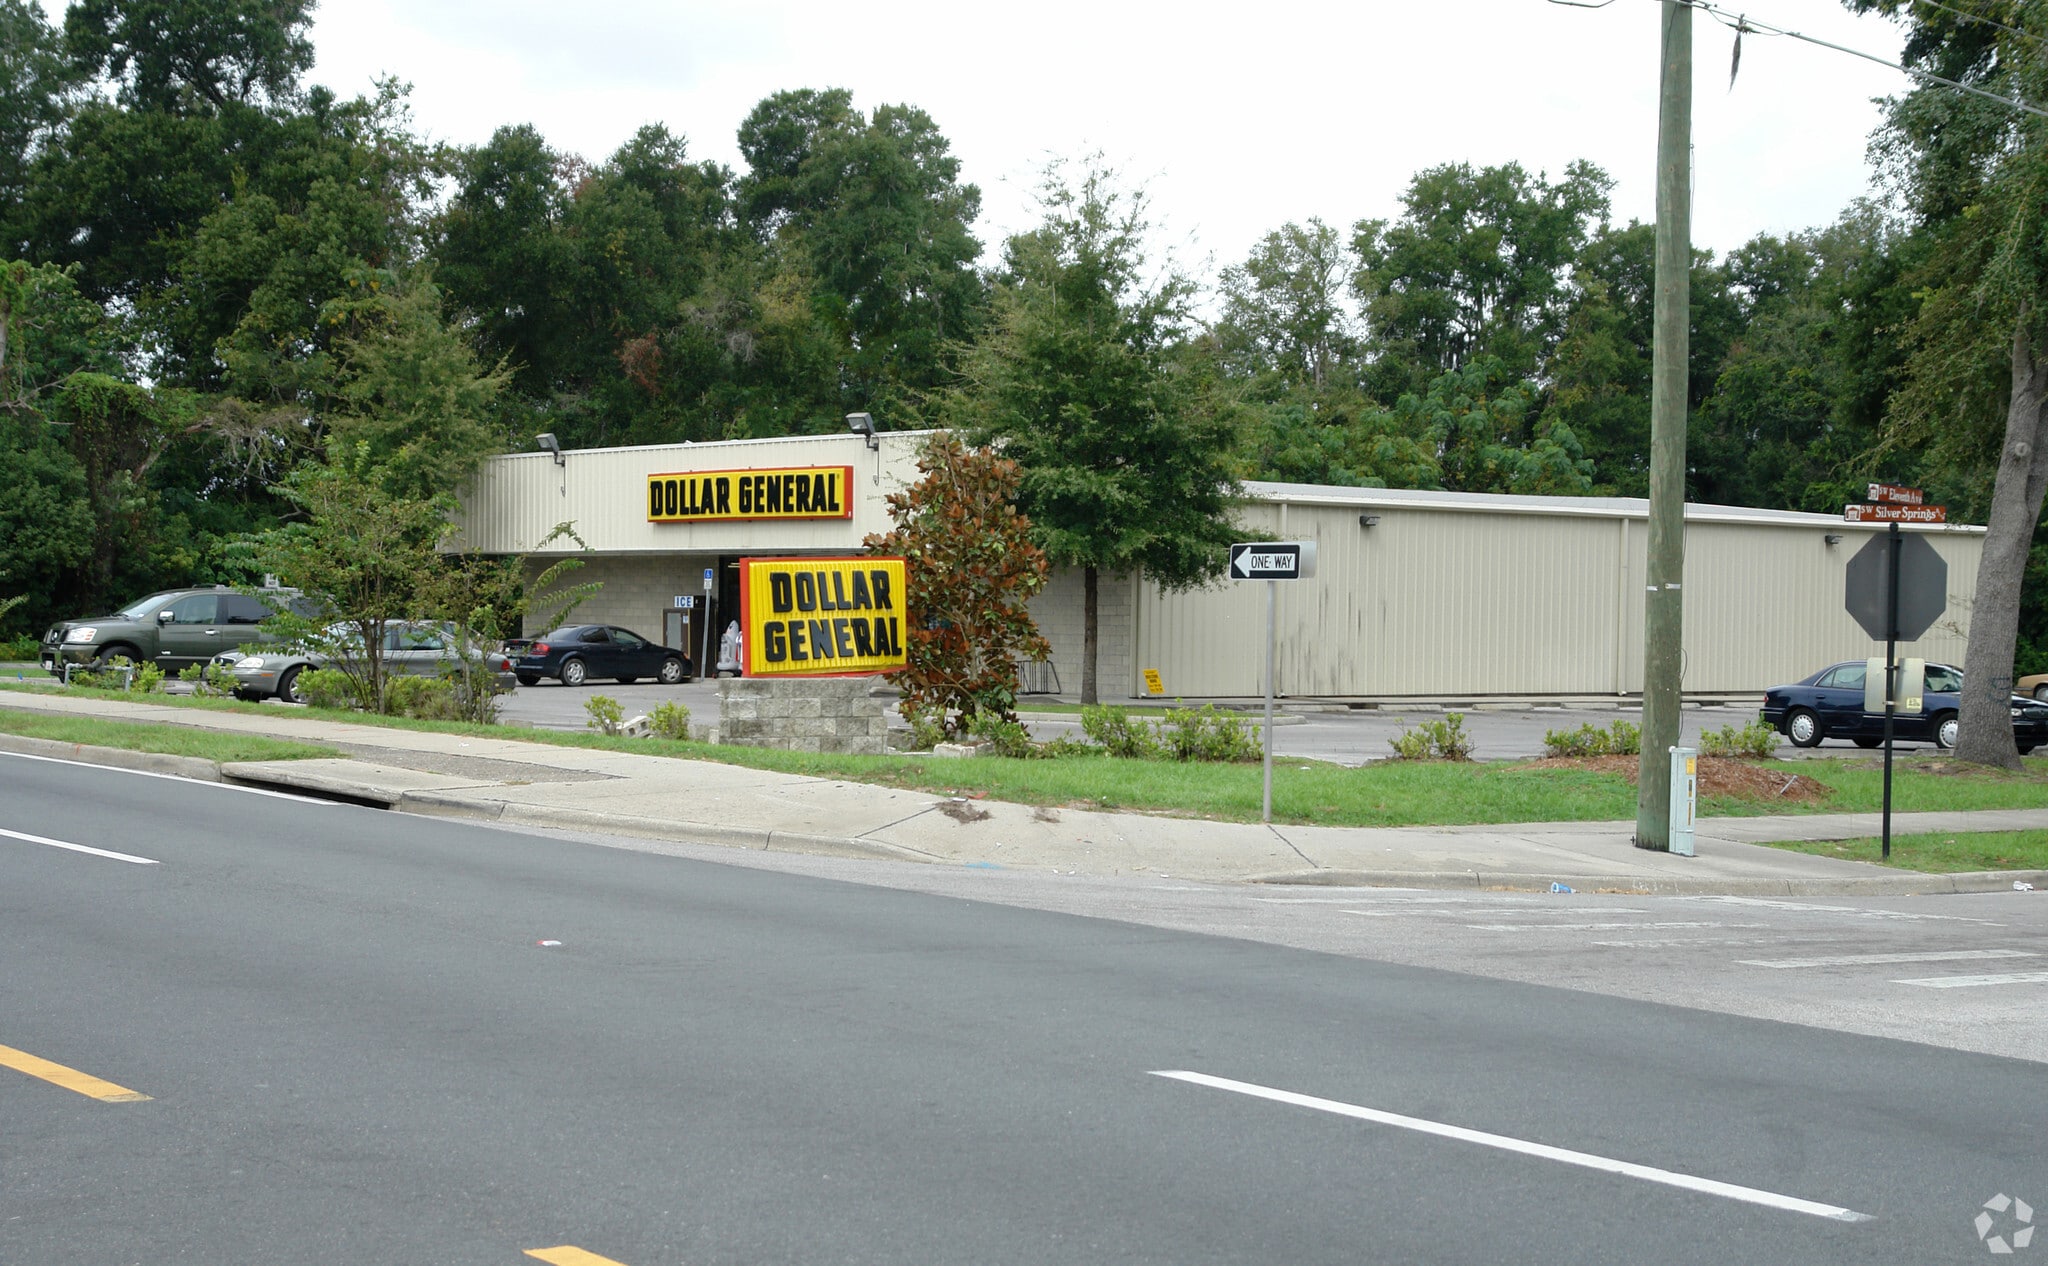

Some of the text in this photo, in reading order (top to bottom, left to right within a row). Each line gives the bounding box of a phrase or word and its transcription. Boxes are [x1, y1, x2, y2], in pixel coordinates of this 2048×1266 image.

[650, 473, 840, 517] DOLLAR GENERAL
[1861, 505, 1873, 514] SW
[1876, 506, 1901, 518] Silver
[1902, 506, 1936, 521] Springs
[1251, 555, 1293, 569] ONE WAY
[676, 596, 692, 607] ICE
[770, 570, 893, 613] DOLLAR
[764, 617, 903, 662] GENERAL
